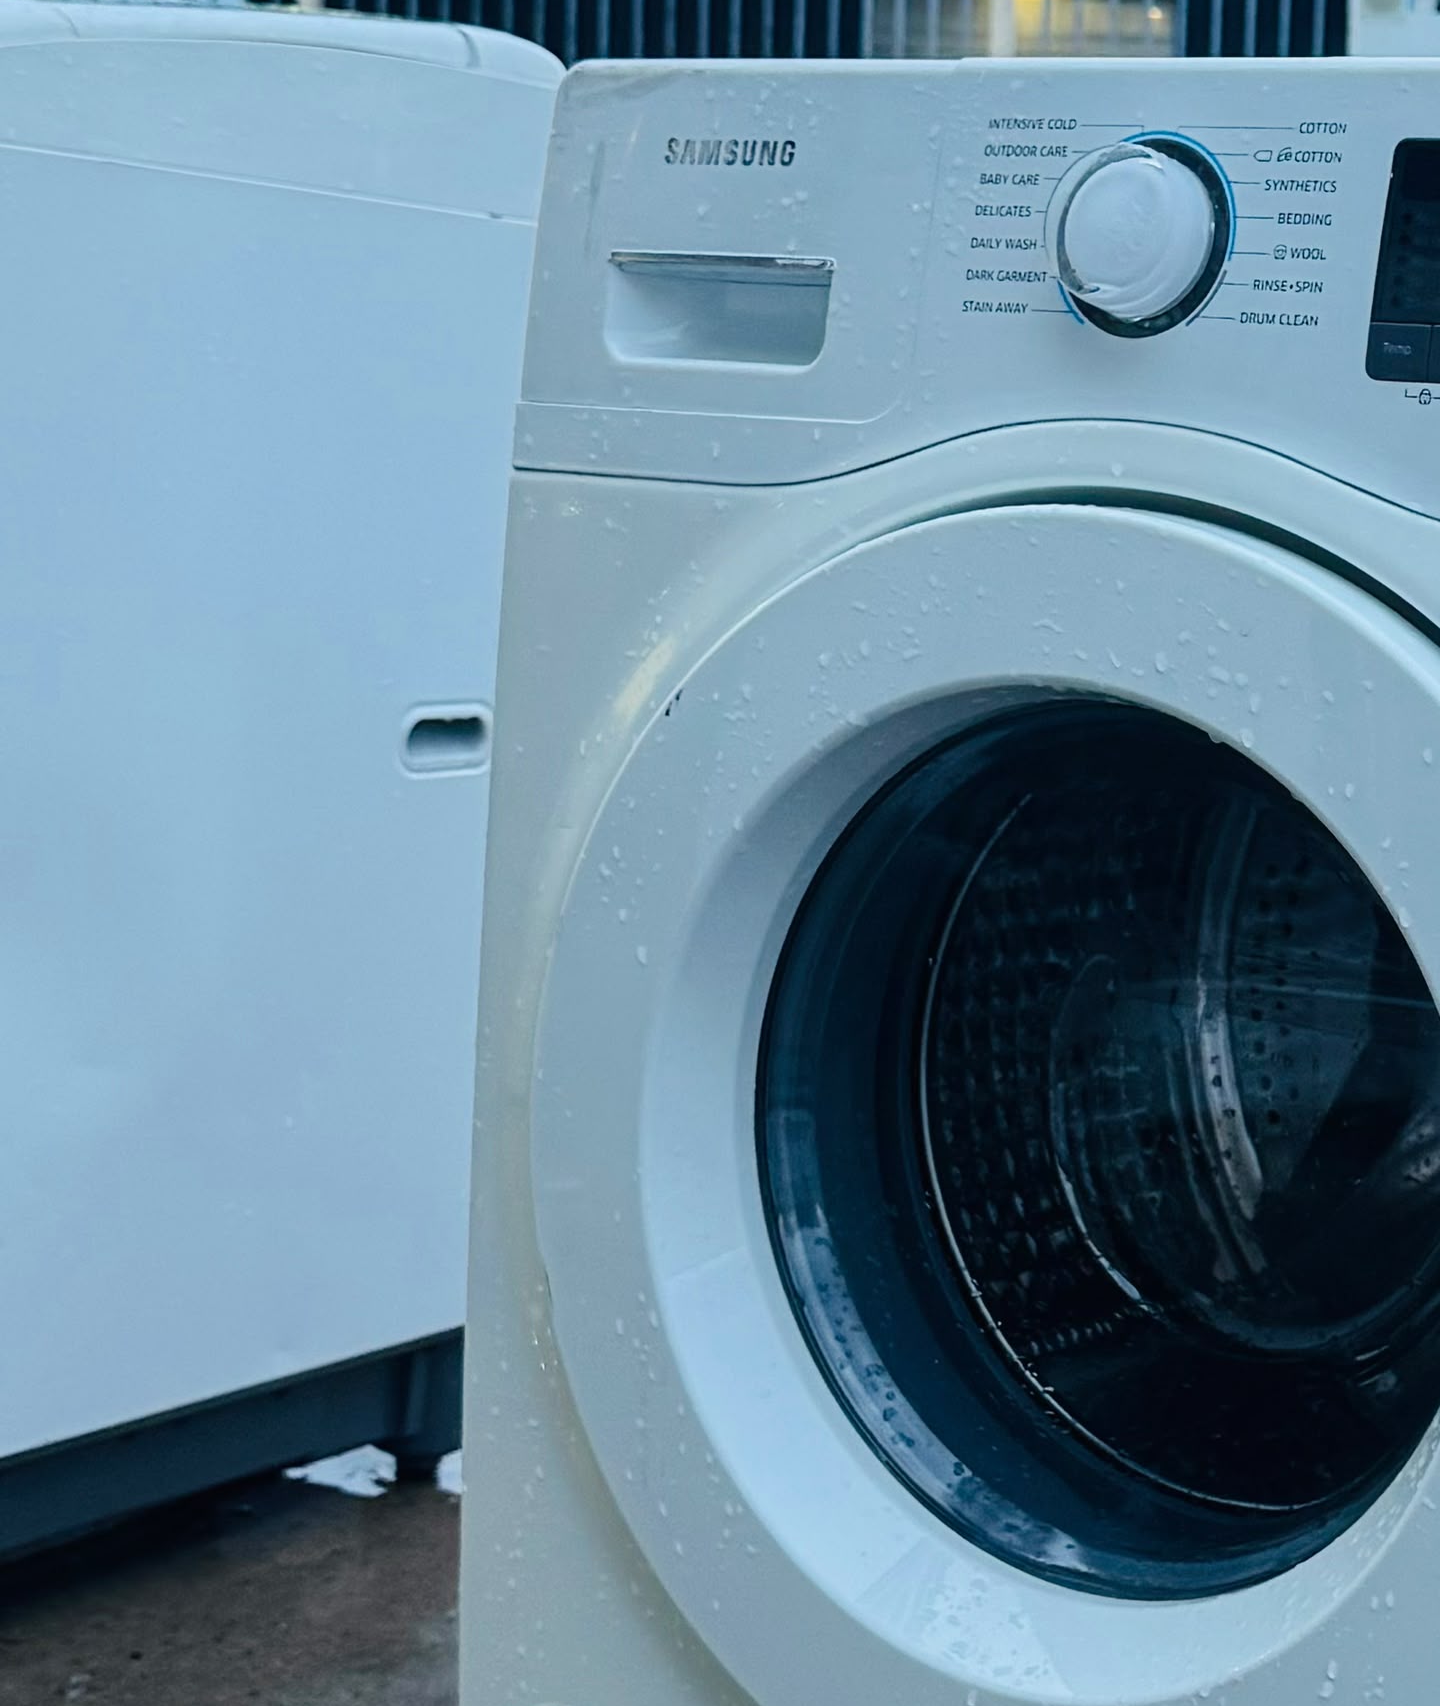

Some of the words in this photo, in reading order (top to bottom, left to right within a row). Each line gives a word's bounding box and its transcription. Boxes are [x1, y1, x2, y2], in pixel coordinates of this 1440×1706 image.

[988, 118, 1045, 130] INTENSIVE
[1048, 118, 1077, 130] COLD
[1299, 122, 1347, 134] COTTON
[664, 137, 796, 166] SAMSUNG
[984, 144, 1037, 157] OUTDOOR
[1040, 145, 1068, 158] CARE
[1294, 151, 1342, 163] COTTON
[979, 173, 1009, 185] BABY
[1012, 173, 1040, 185] CARE
[1264, 179, 1337, 193] SYNTHETICS
[975, 205, 1032, 217] DELICATES
[1277, 212, 1332, 226] BEDDING
[970, 237, 1002, 249] DAILY
[1005, 238, 1037, 250] WASH
[1290, 247, 1326, 260] WOOL
[966, 269, 994, 281] DARK
[997, 270, 1048, 283] GARMENT
[962, 300, 993, 312] STAIN
[995, 301, 1028, 314] AWAY
[1239, 311, 1276, 324] DRUM
[1279, 313, 1319, 326] CLEAN
